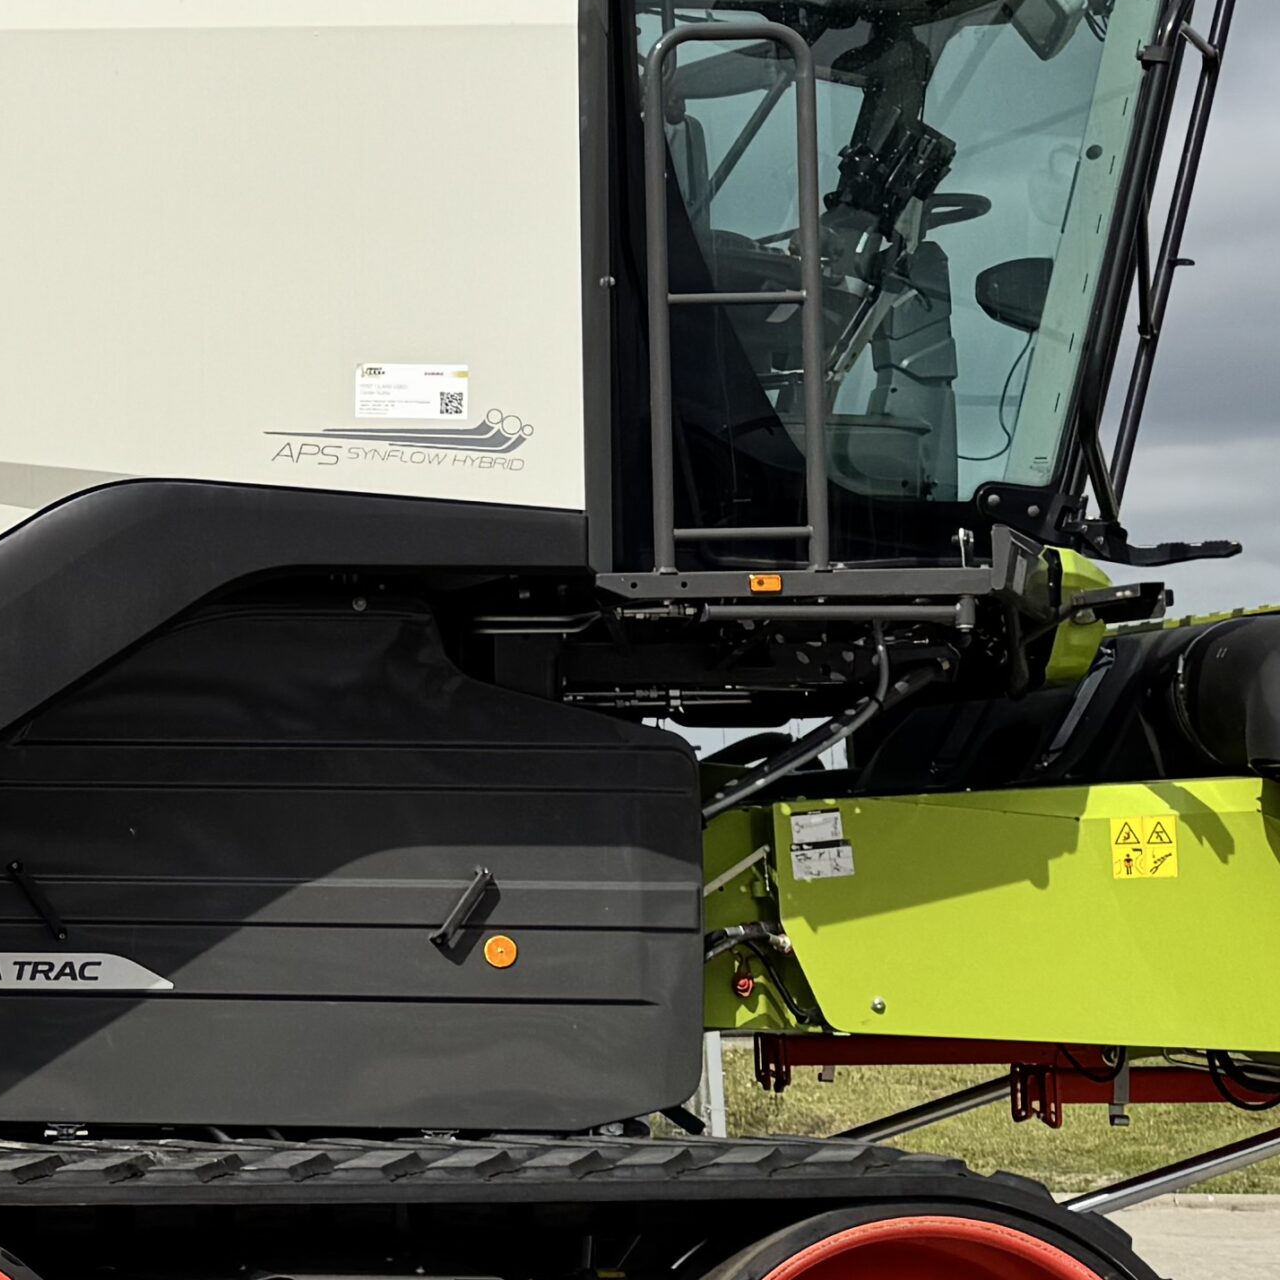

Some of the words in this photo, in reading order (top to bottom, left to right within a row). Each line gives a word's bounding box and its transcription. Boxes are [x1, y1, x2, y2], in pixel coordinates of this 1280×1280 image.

[271, 442, 343, 466] APS
[347, 446, 447, 466] SYNFLOW
[451, 455, 525, 471] HYBRID
[12, 960, 103, 981] TRAC
